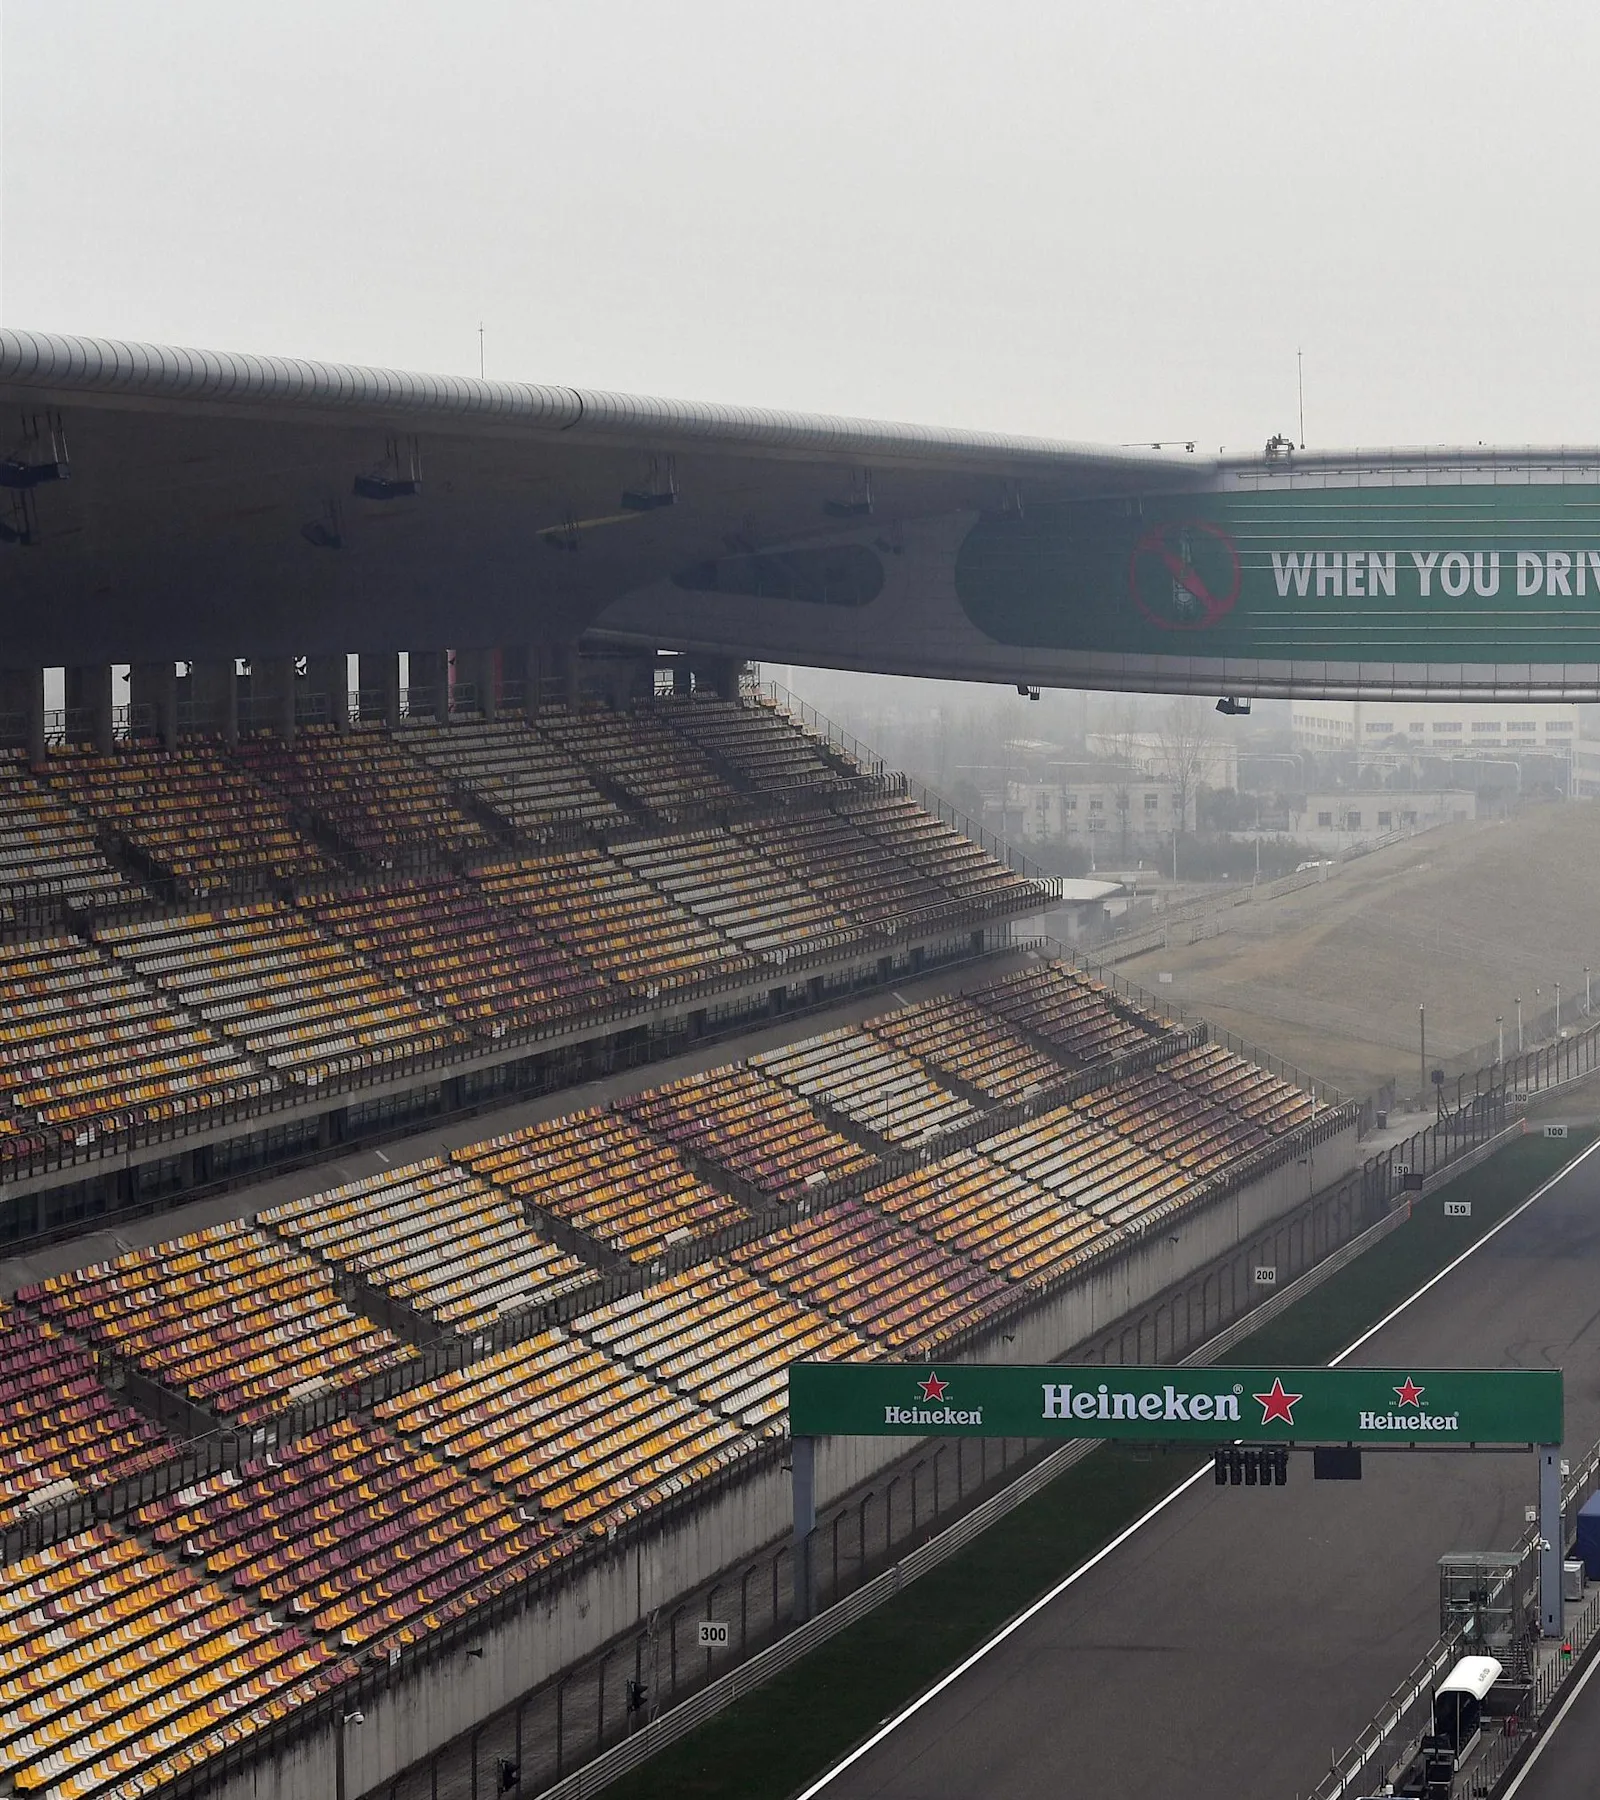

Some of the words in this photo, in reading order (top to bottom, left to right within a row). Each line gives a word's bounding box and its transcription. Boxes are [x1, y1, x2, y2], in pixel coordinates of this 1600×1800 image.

[1272, 552, 1396, 597] WHEN
[1411, 552, 1500, 597] YOU
[1547, 1128, 1563, 1136] 100
[1449, 1205, 1466, 1214] 150
[1256, 1270, 1274, 1280] 200
[701, 1627, 726, 1641] 300
